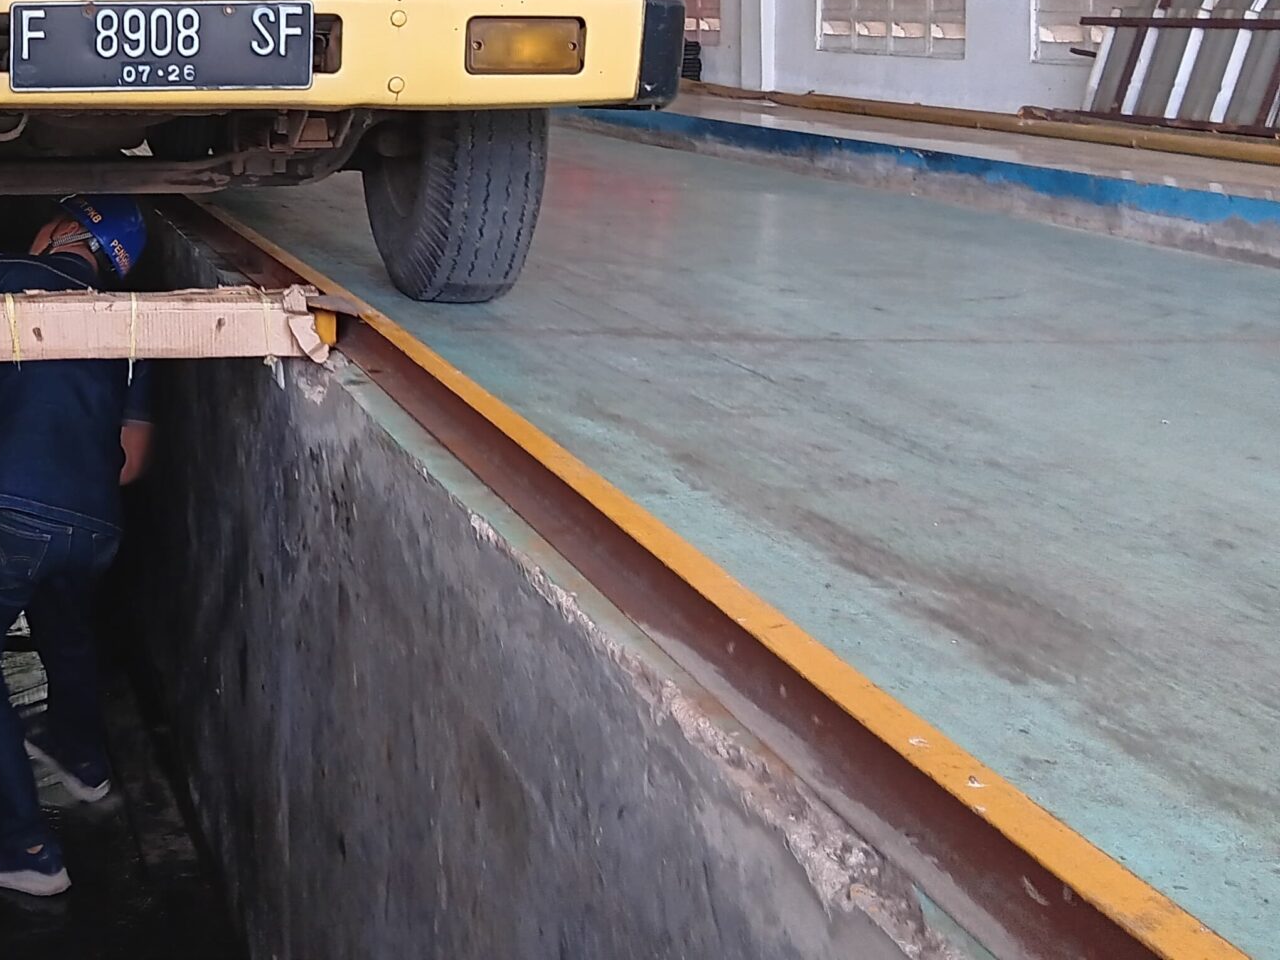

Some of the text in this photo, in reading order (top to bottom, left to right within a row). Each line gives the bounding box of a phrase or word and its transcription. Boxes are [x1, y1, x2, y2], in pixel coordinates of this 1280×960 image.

[21, 5, 303, 60] F 8908 SF
